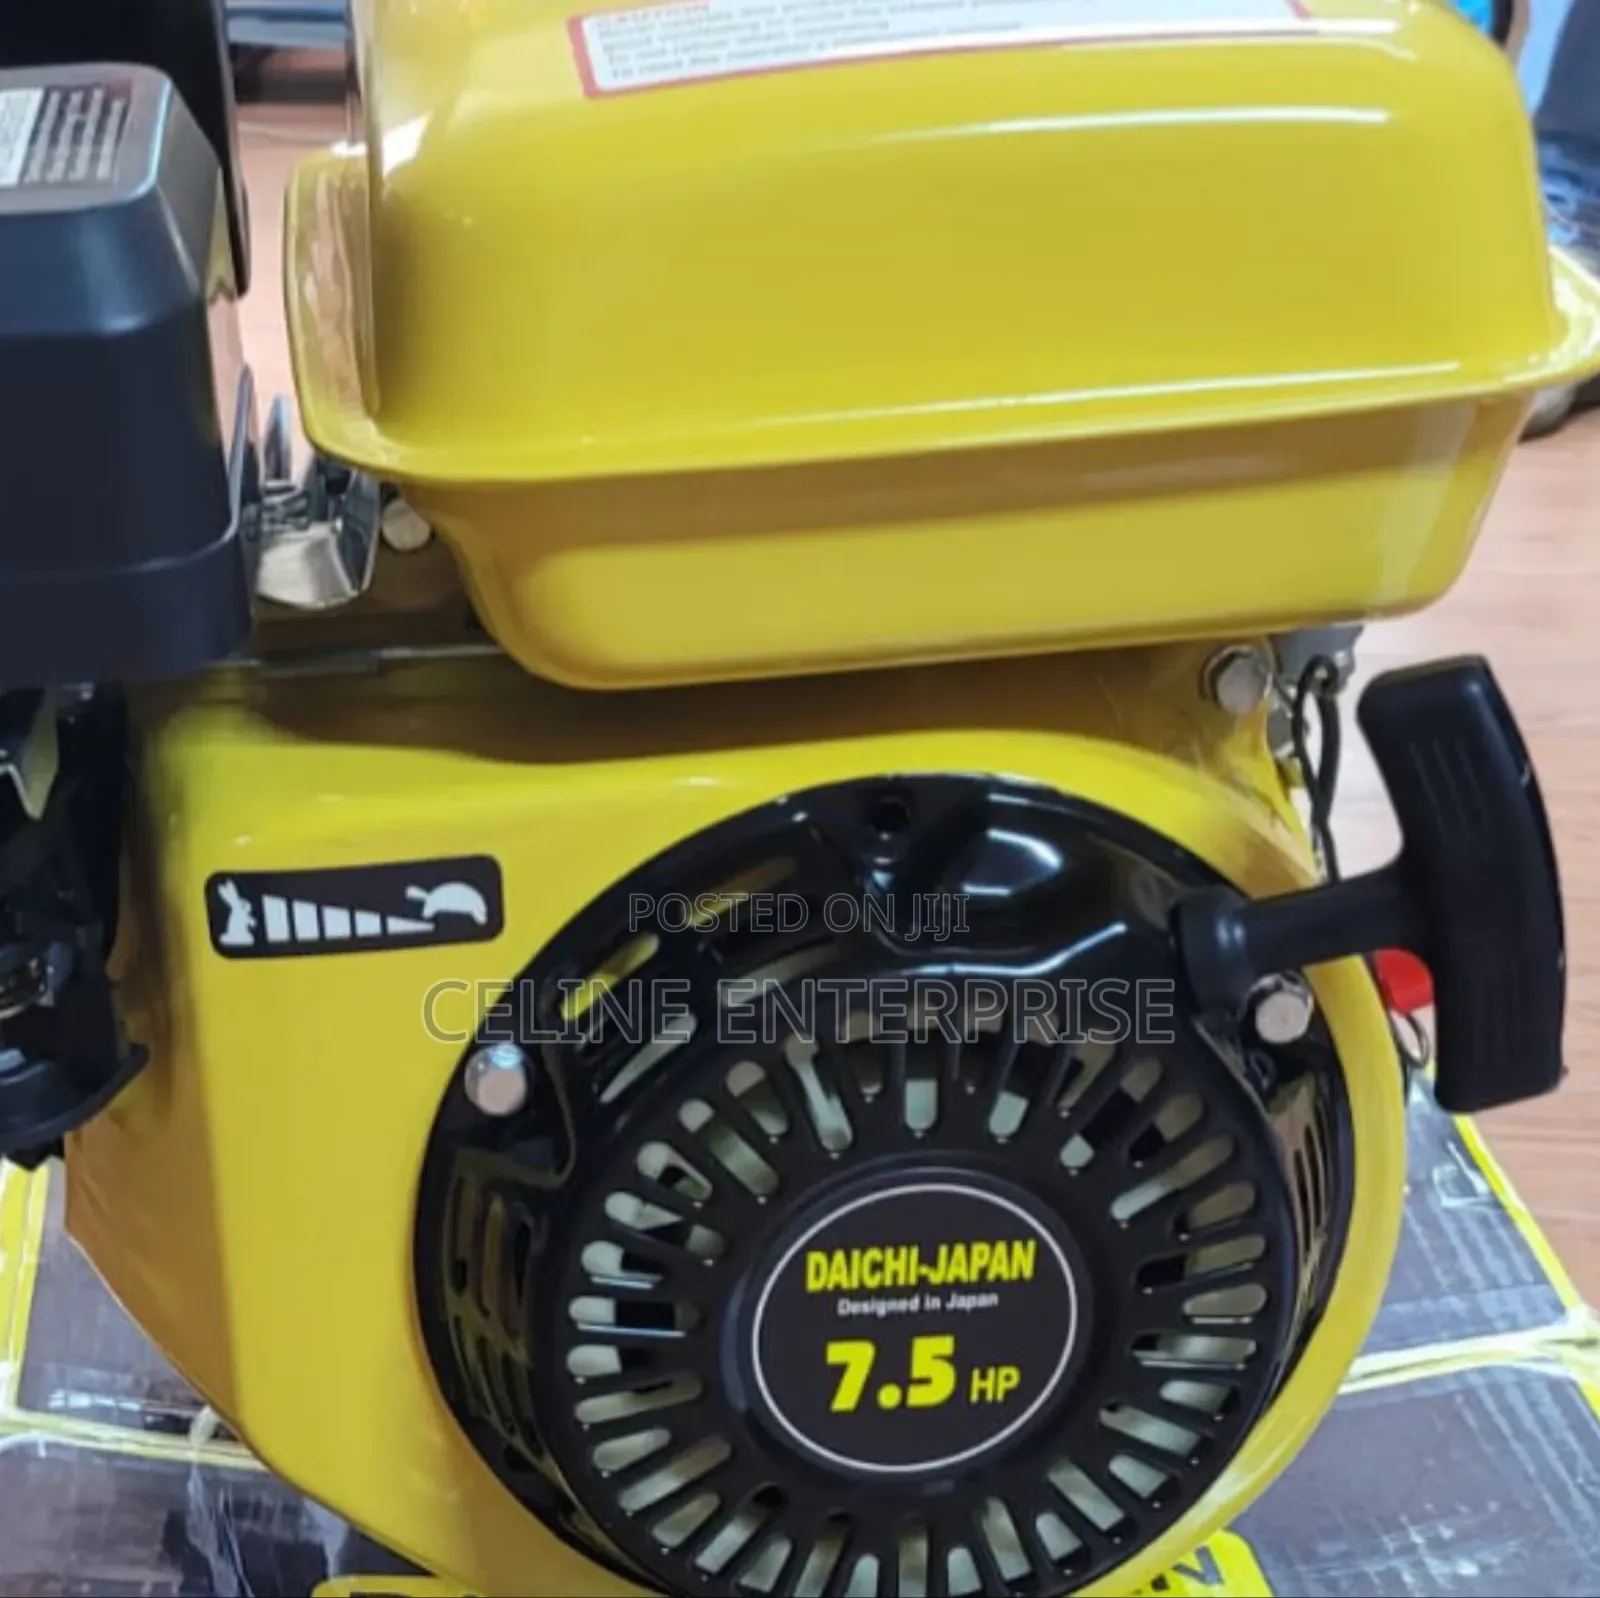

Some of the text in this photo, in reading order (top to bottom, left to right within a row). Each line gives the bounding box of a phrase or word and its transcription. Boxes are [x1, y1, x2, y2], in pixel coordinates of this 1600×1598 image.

[805, 1239, 1036, 1292] DAICHI-JAPAN
[836, 1291, 999, 1318] Designed in Japan
[825, 1333, 1021, 1412] 7.5 HP
